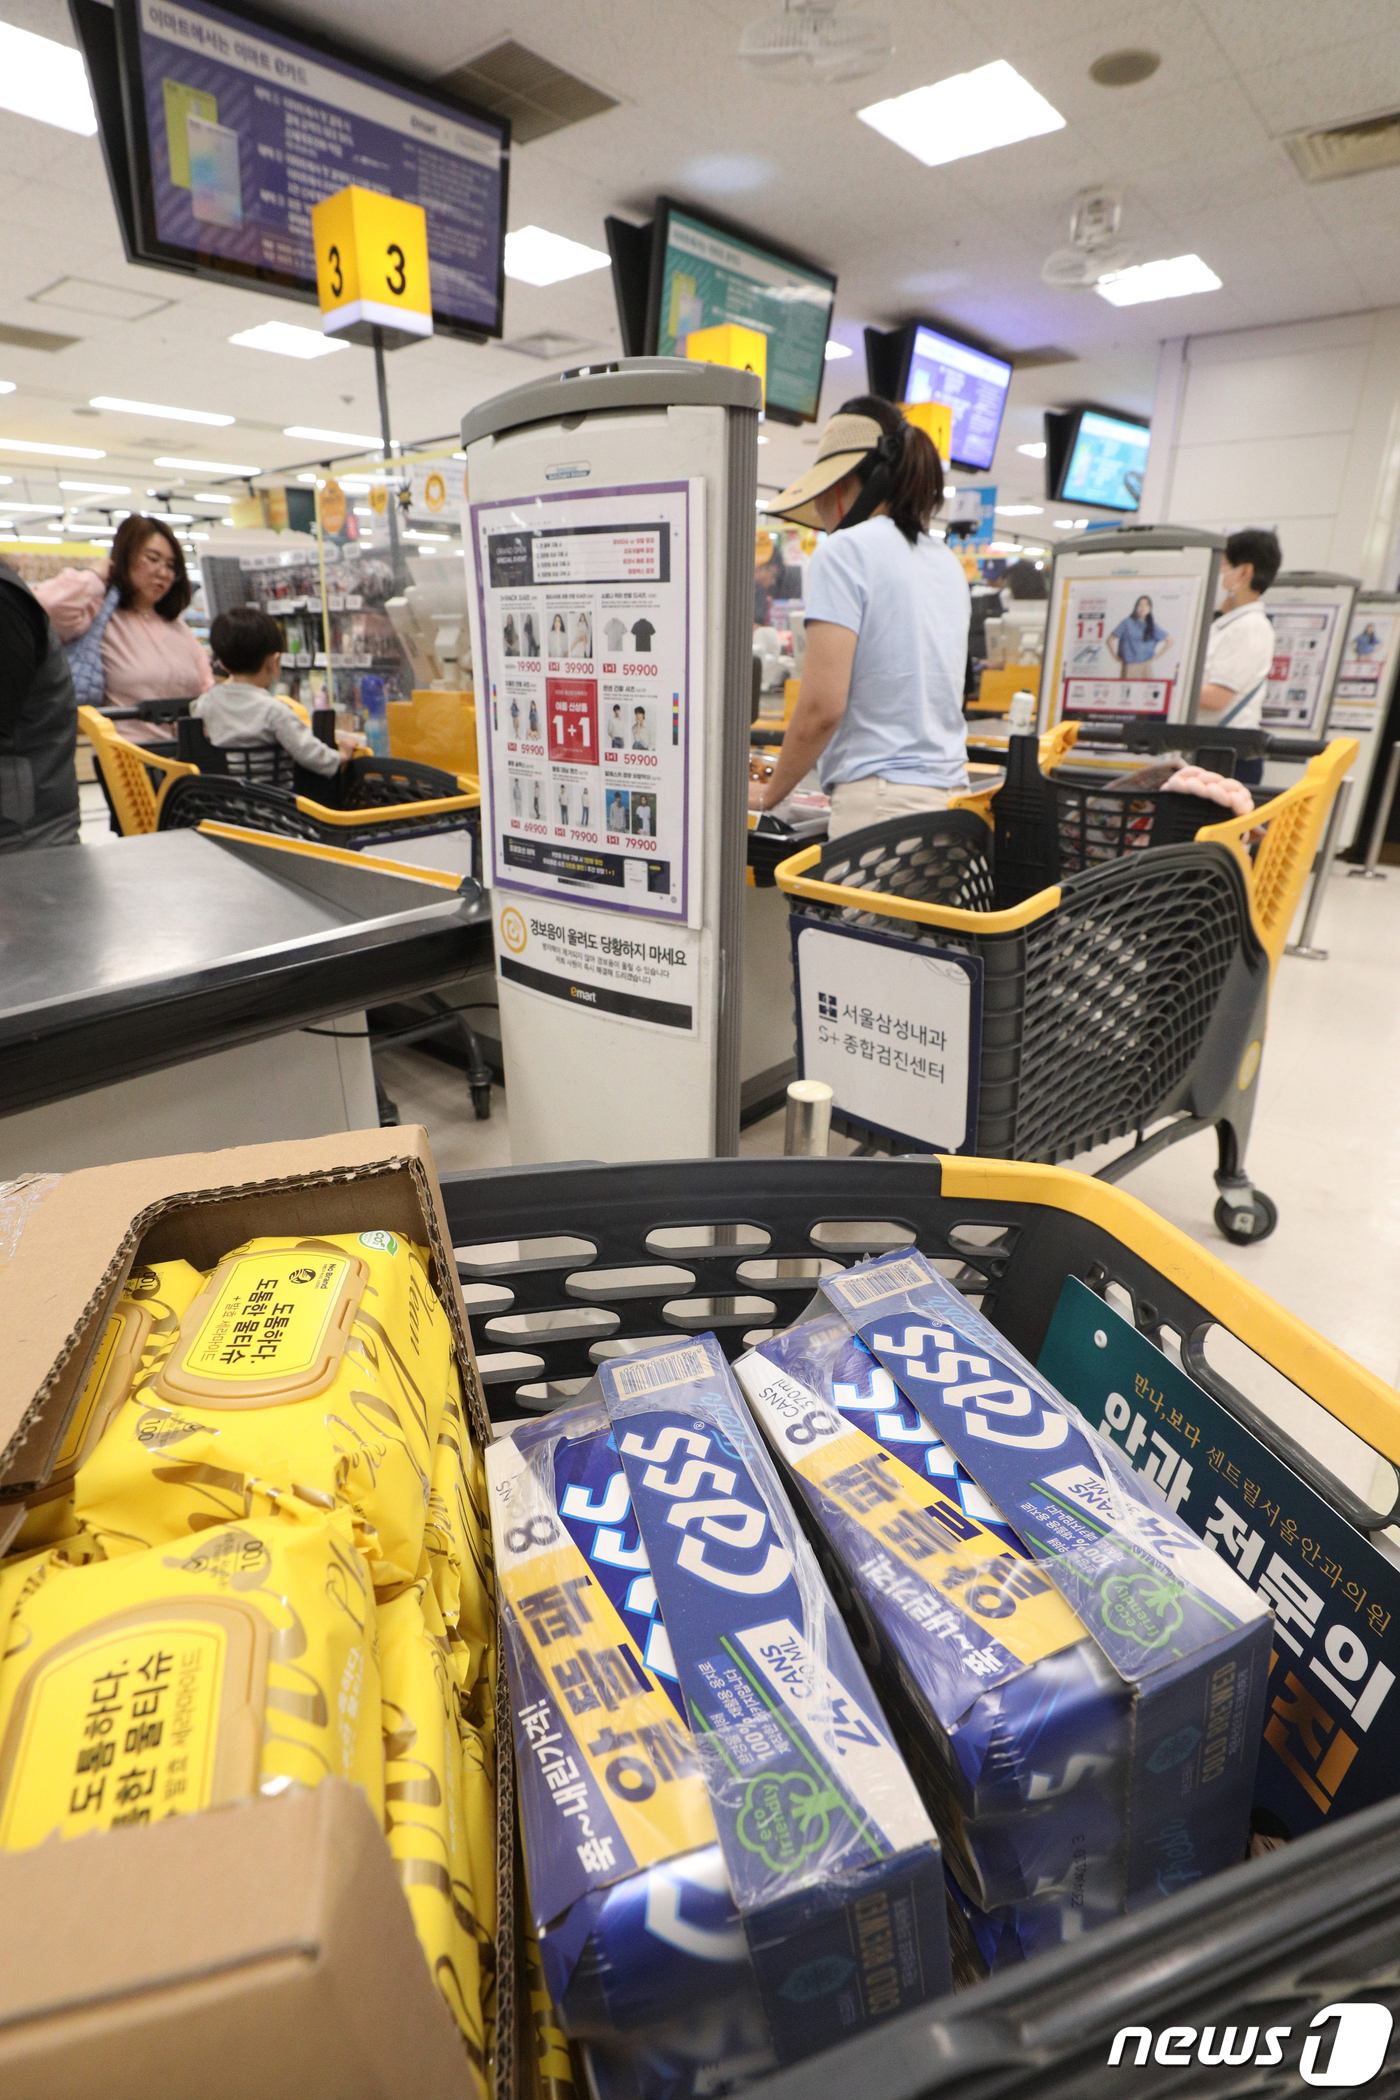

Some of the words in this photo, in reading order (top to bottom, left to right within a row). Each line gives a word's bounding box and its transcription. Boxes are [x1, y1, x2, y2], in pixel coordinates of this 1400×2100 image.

[328, 245, 343, 298] 3
[385, 244, 406, 295] 3
[552, 715, 591, 747] 1+1
[530, 918, 565, 943] 경보음이
[567, 928, 598, 950] 울려도
[601, 936, 646, 961] 당황하지
[650, 945, 687, 966] 마세요
[614, 970, 651, 984] 드리겠습니다
[635, 965, 642, 973] 수
[643, 965, 670, 978] 있습니다
[570, 986, 596, 1003] emart
[842, 1004, 947, 1052] 서울삼성내과
[843, 1034, 945, 1084] 종합검진센터
[140, 1271, 156, 1289] 100
[242, 1278, 279, 1315] 도톰한
[222, 1301, 239, 1319] 발효
[200, 1319, 223, 1363] 세라마이드
[218, 1319, 261, 1365] 물티슈
[250, 1302, 294, 1364] 도톰하다.
[759, 1385, 800, 1419] CANS
[138, 1419, 161, 1442] 100
[785, 1409, 841, 1446] 8
[1020, 1502, 1050, 1522] 용지로
[1044, 1504, 1098, 1542] 패키지입니다
[1134, 1373, 1202, 1450] 만나,보다
[1205, 1446, 1393, 1639] 센트럴서울안과의원
[504, 1514, 560, 1554] 8
[821, 1452, 1054, 1620] 알뜰팩
[1045, 1520, 1077, 1541] 재활용
[1047, 1537, 1070, 1554] 위해
[1137, 1516, 1203, 1559] 24
[240, 1538, 264, 1572] 100
[1072, 1536, 1114, 1569] 100%
[1101, 1391, 1195, 1511] 안과
[1203, 1495, 1397, 1735] 전문의
[860, 1553, 1004, 1677] 쭉~내린가격!
[1115, 1584, 1160, 1637] friendly
[1115, 1603, 1136, 1628] eco
[777, 1635, 807, 1662] ML
[516, 1575, 695, 1803] 알뜰팩
[698, 1661, 726, 1689] 용지로
[759, 1644, 812, 1699] CANS
[124, 1650, 175, 1756] 물티슈
[717, 1690, 744, 1719] 재활용
[722, 1668, 773, 1723] 패키지입니다
[1213, 1661, 1236, 1733] BREWED
[709, 1712, 730, 1733] 위해
[735, 1717, 775, 1762] 100%
[761, 1723, 792, 1755] 제작한
[1262, 1648, 1360, 1816] 진
[1202, 1732, 1228, 1783] COLD
[518, 1698, 617, 1873] 쭉~내린가격!
[764, 1780, 797, 1859] friendly
